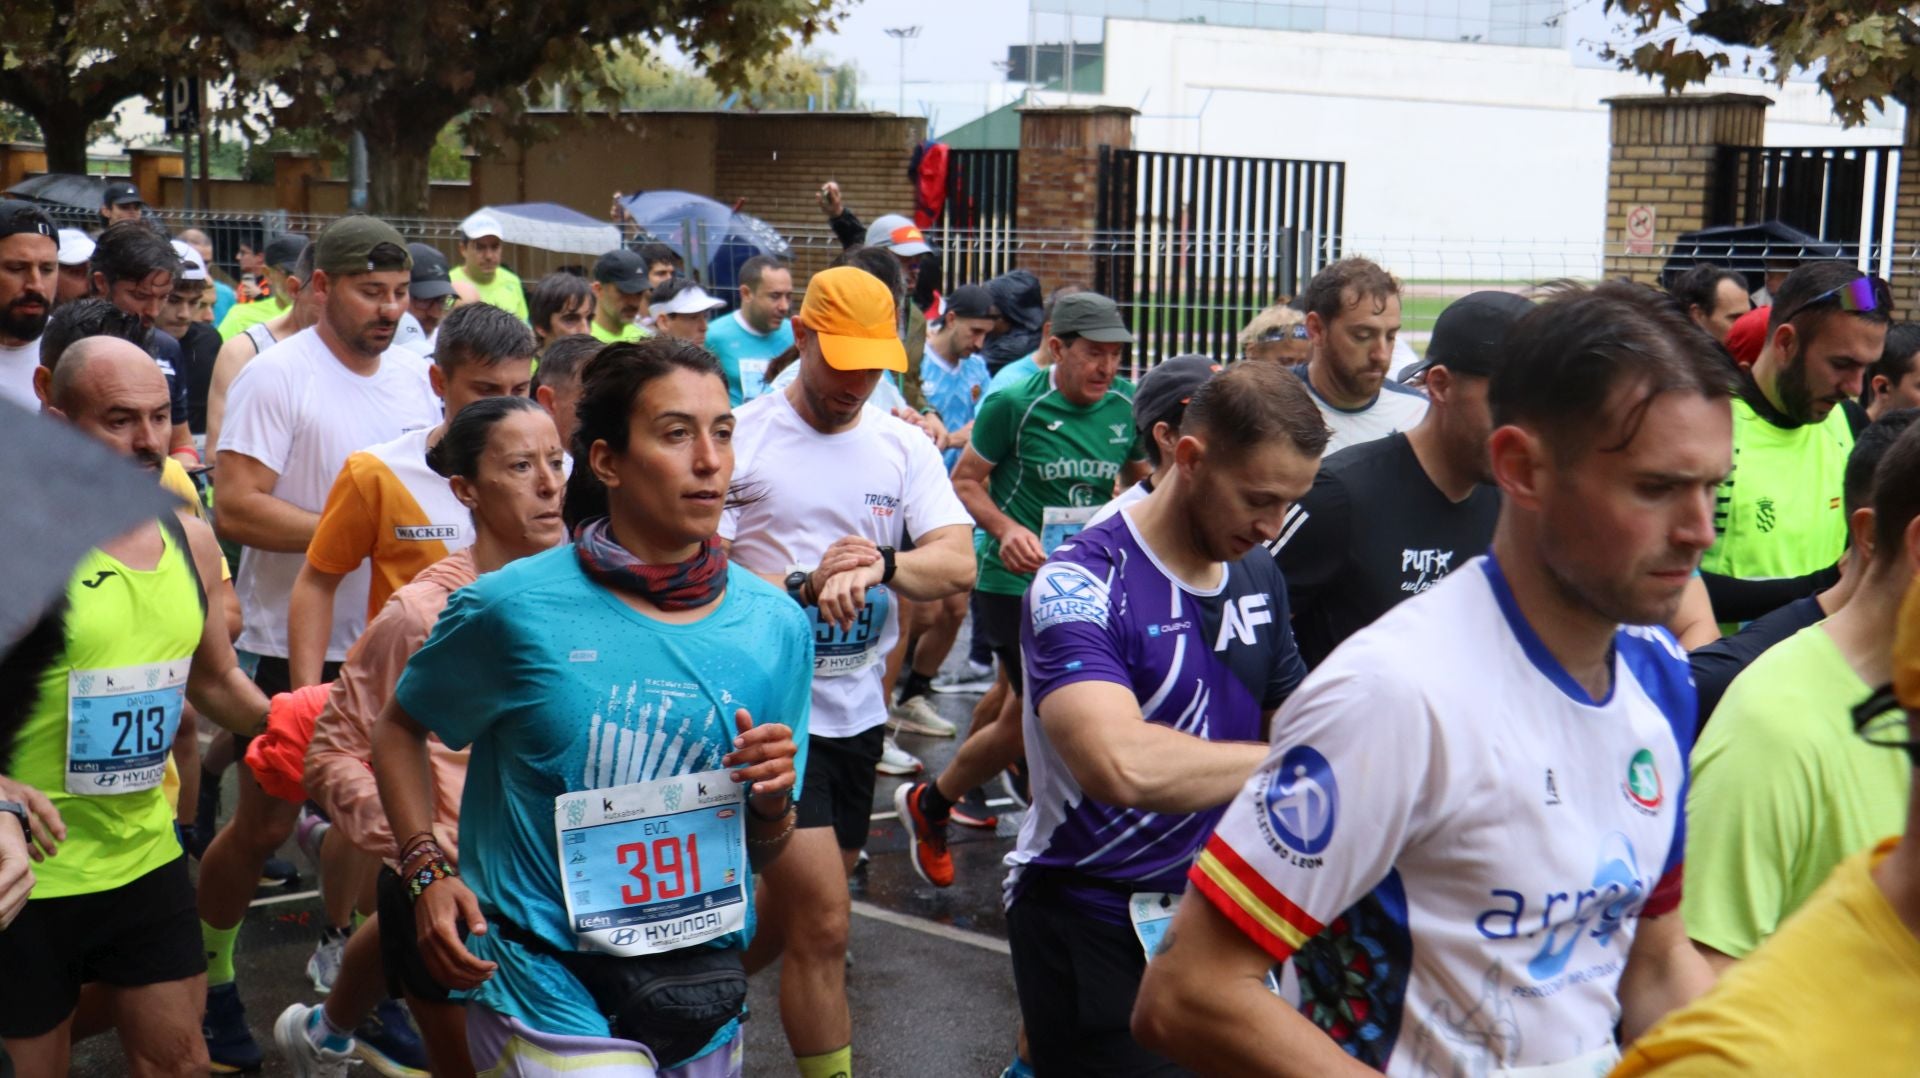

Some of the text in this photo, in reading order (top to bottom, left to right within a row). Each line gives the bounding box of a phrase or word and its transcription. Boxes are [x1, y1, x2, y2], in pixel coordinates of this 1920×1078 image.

[173, 77, 189, 128] P
[397, 528, 455, 538] WACKER
[816, 603, 873, 643] 59
[1213, 594, 1272, 651] AF
[126, 694, 155, 707] DAVID
[111, 706, 165, 757] 213
[644, 821, 670, 836] EVI
[616, 833, 702, 905] 391
[645, 912, 722, 941] HYUNDAI
